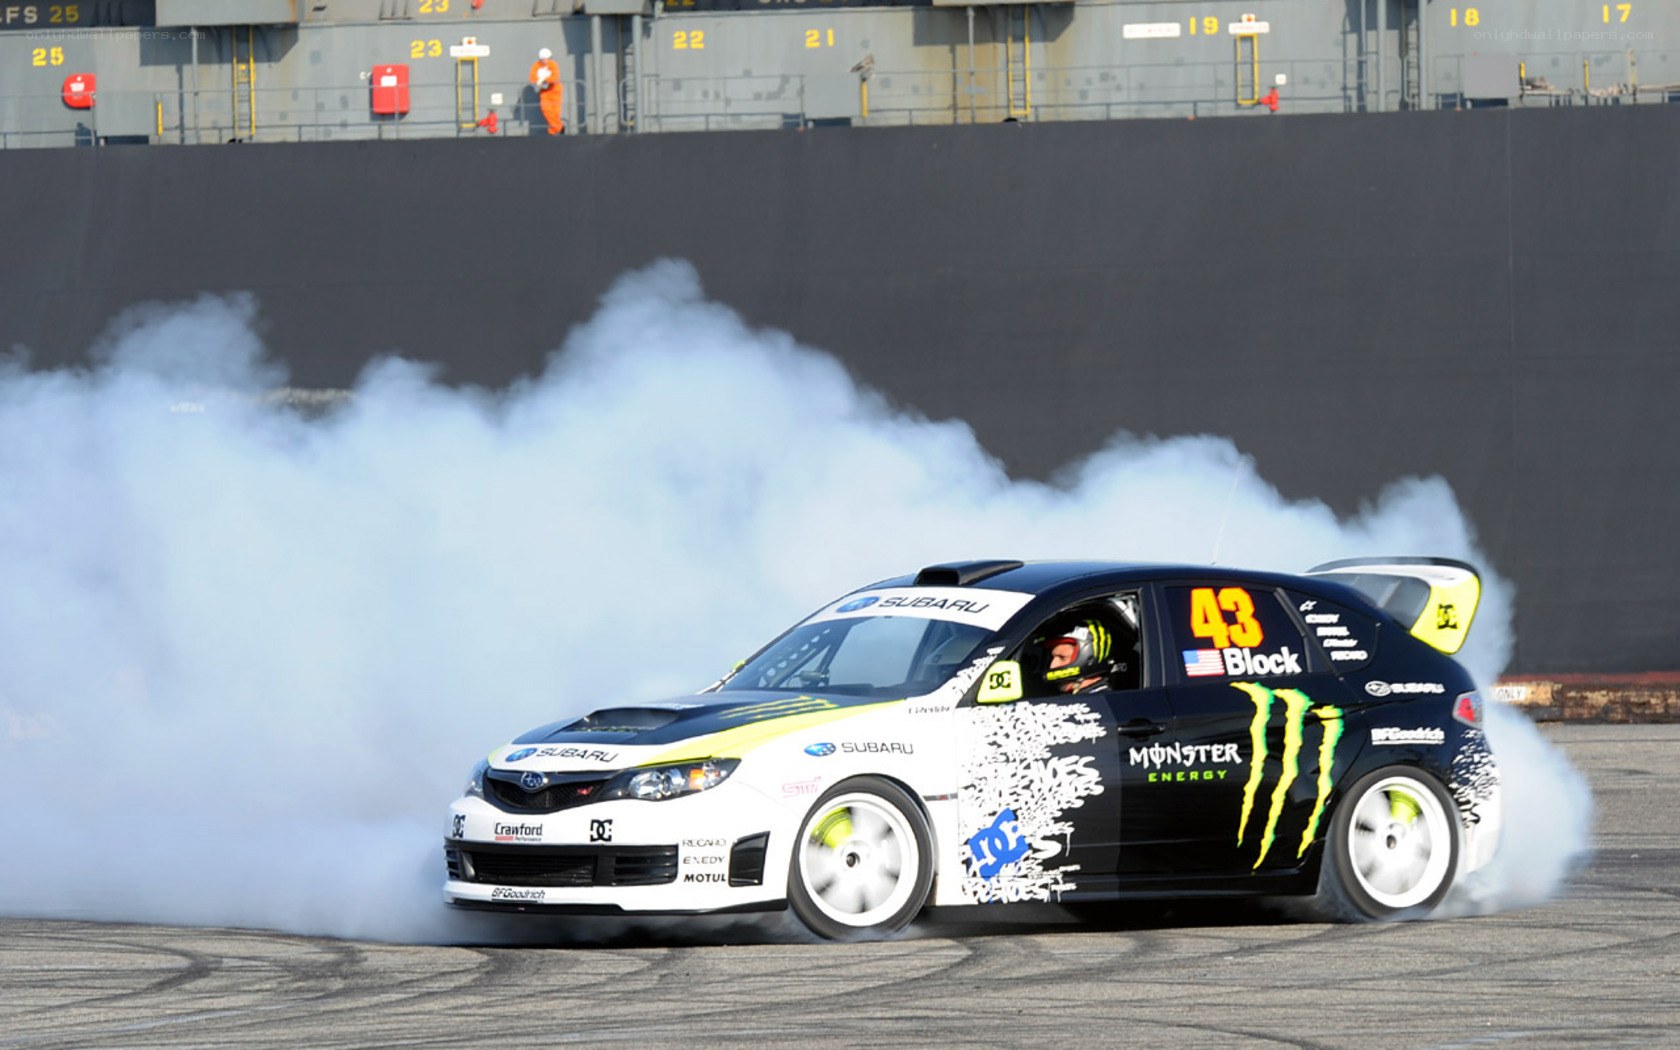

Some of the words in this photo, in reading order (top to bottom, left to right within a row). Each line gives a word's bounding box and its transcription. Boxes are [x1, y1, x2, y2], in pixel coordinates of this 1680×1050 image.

[0, 5, 38, 24] FS
[49, 4, 80, 23] 25
[1450, 8, 1480, 26] 18
[1602, 3, 1632, 23] 17
[1189, 16, 1219, 35] 19
[673, 30, 705, 49] 22
[805, 28, 834, 48] 21
[32, 46, 65, 66] 25
[410, 39, 443, 59] 23
[878, 596, 990, 614] SUBARU
[1190, 587, 1264, 650] 43
[1224, 647, 1302, 676] Block
[988, 670, 1011, 690] DC
[536, 747, 619, 763] SUBARU
[841, 742, 914, 755] SUBARU
[1147, 769, 1227, 783] ENERGY
[494, 822, 543, 836] Crawford
[589, 819, 613, 842] DC
[683, 873, 727, 883] MOTUL
[491, 887, 546, 899] BFGoodrich
